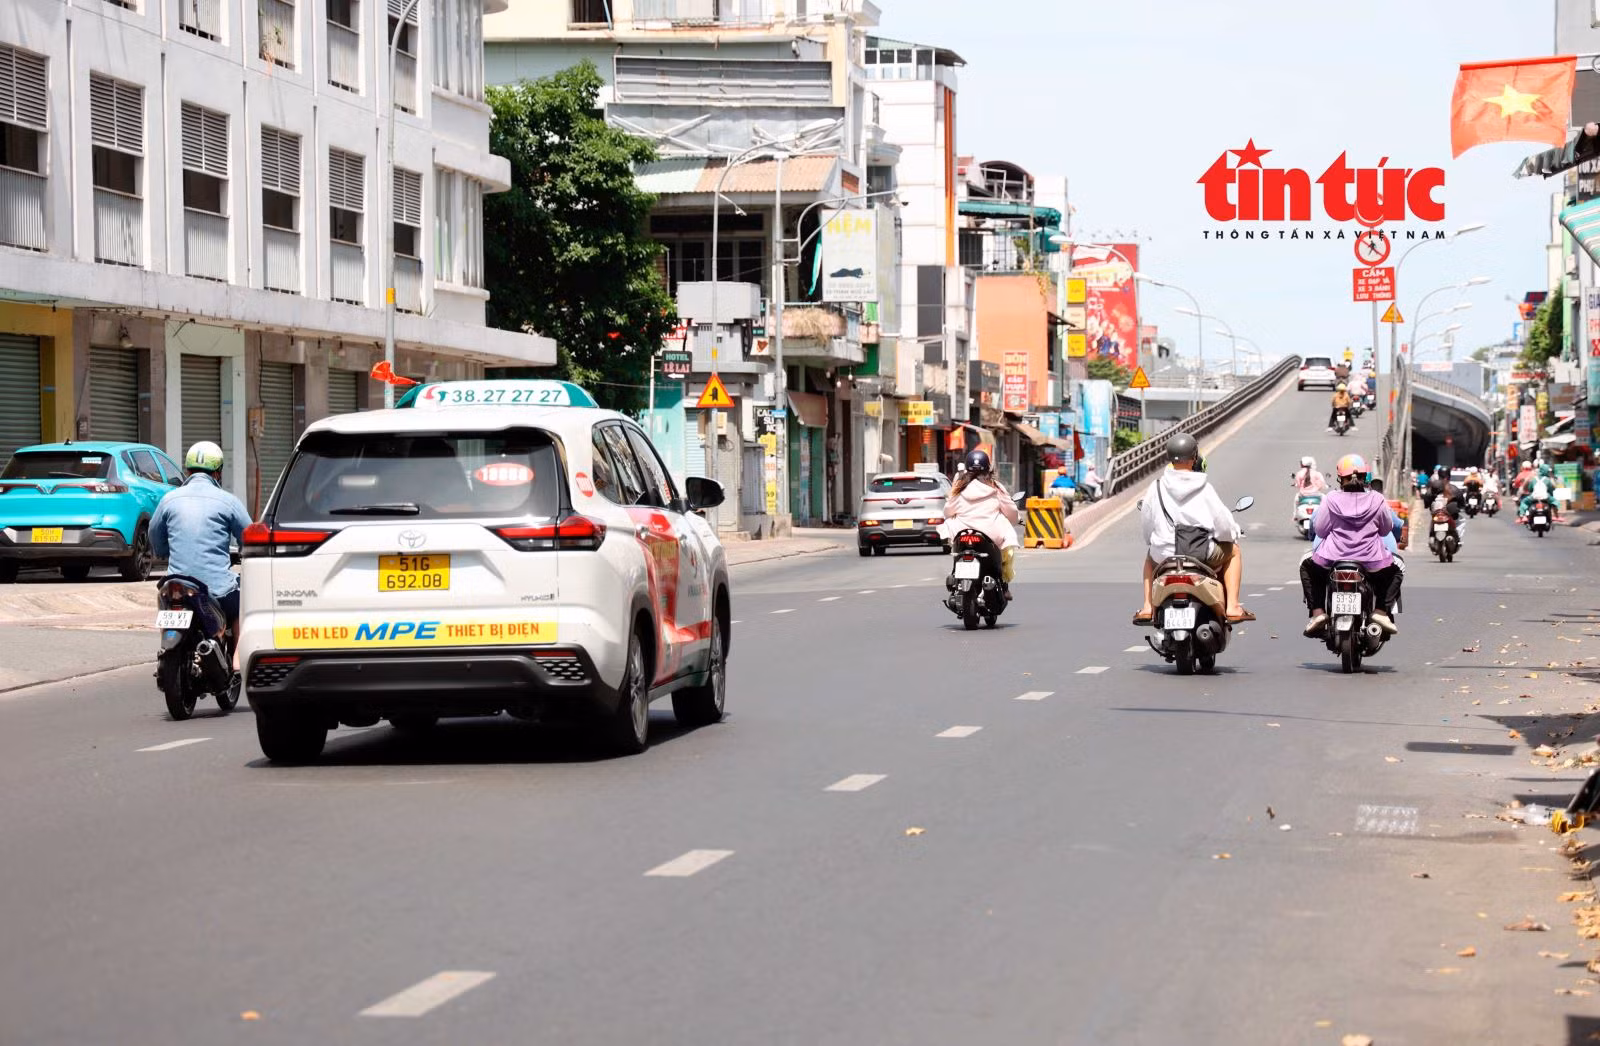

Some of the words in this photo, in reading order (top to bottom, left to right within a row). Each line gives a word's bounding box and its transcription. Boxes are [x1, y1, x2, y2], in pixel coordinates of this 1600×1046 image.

[665, 353, 689, 361] HOTEL
[676, 363, 690, 373] LAI
[452, 389, 506, 403] 38.27
[512, 389, 534, 402] 27
[540, 389, 562, 402] 27
[399, 557, 430, 571] 51G
[386, 573, 442, 589] 692.08
[324, 626, 349, 639] LED
[354, 621, 441, 641] MPE
